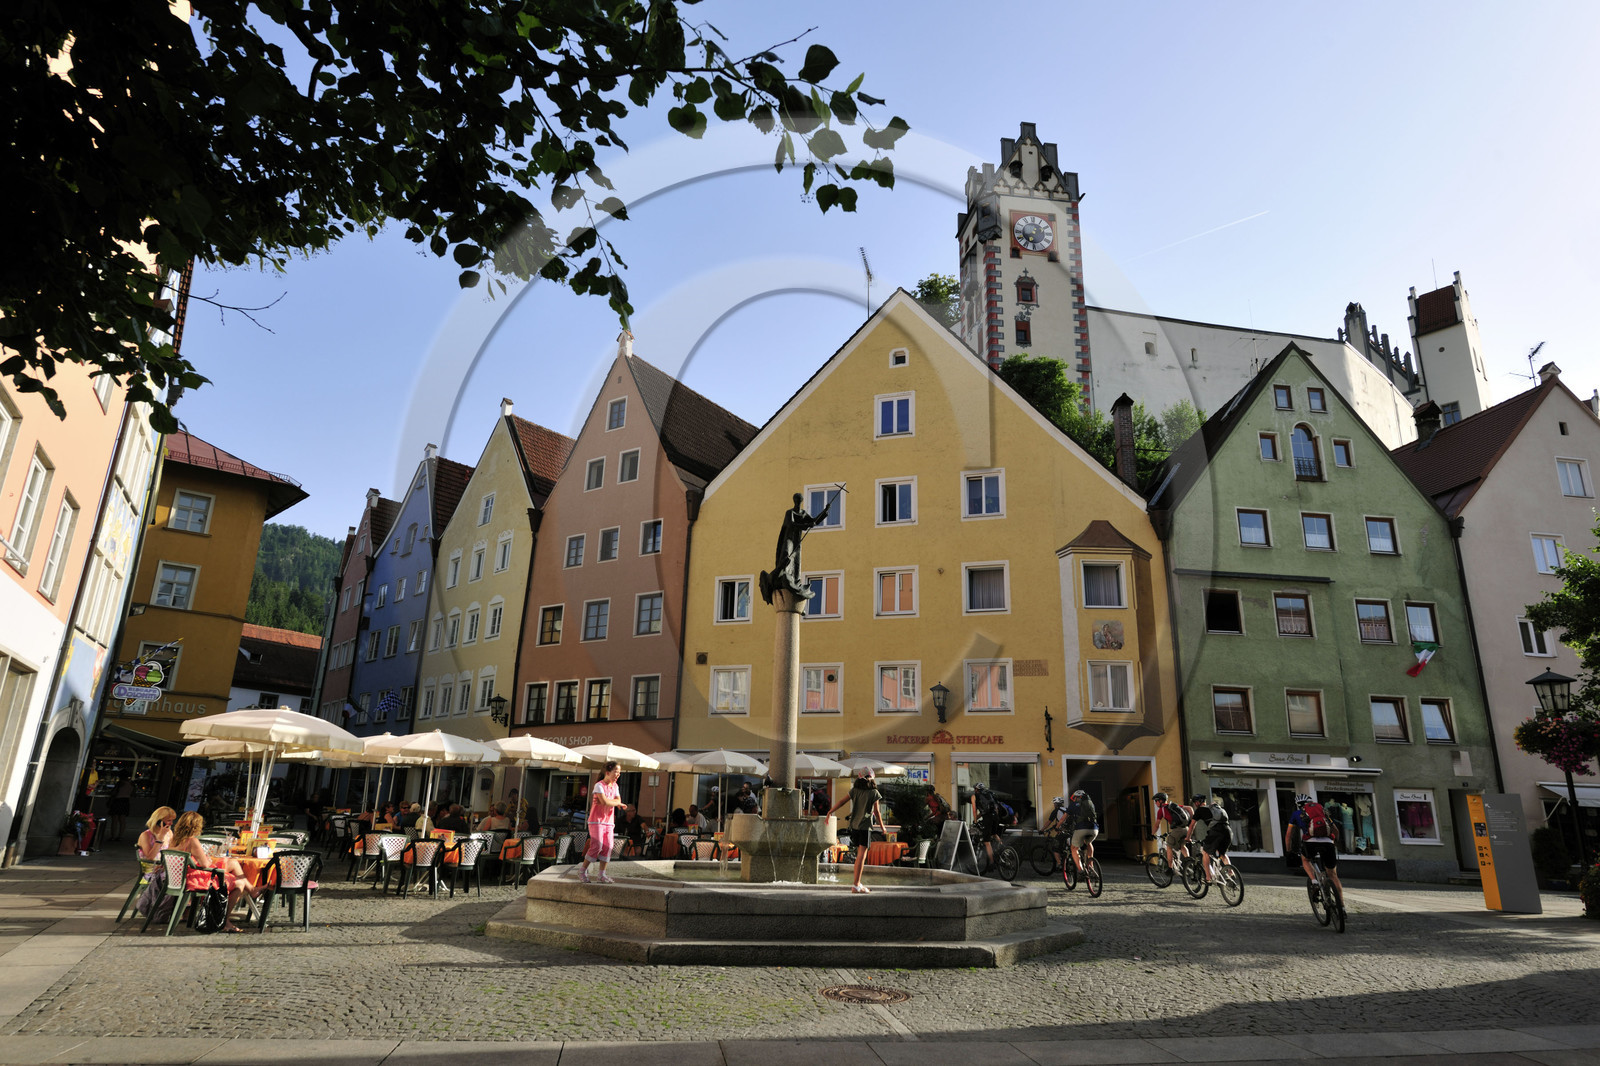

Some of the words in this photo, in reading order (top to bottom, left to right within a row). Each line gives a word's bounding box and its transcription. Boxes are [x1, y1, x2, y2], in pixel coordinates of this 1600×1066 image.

[569, 735, 593, 746] SHOP
[886, 734, 930, 745] BÄCKEREI
[956, 735, 1004, 745] STEHCAFE
